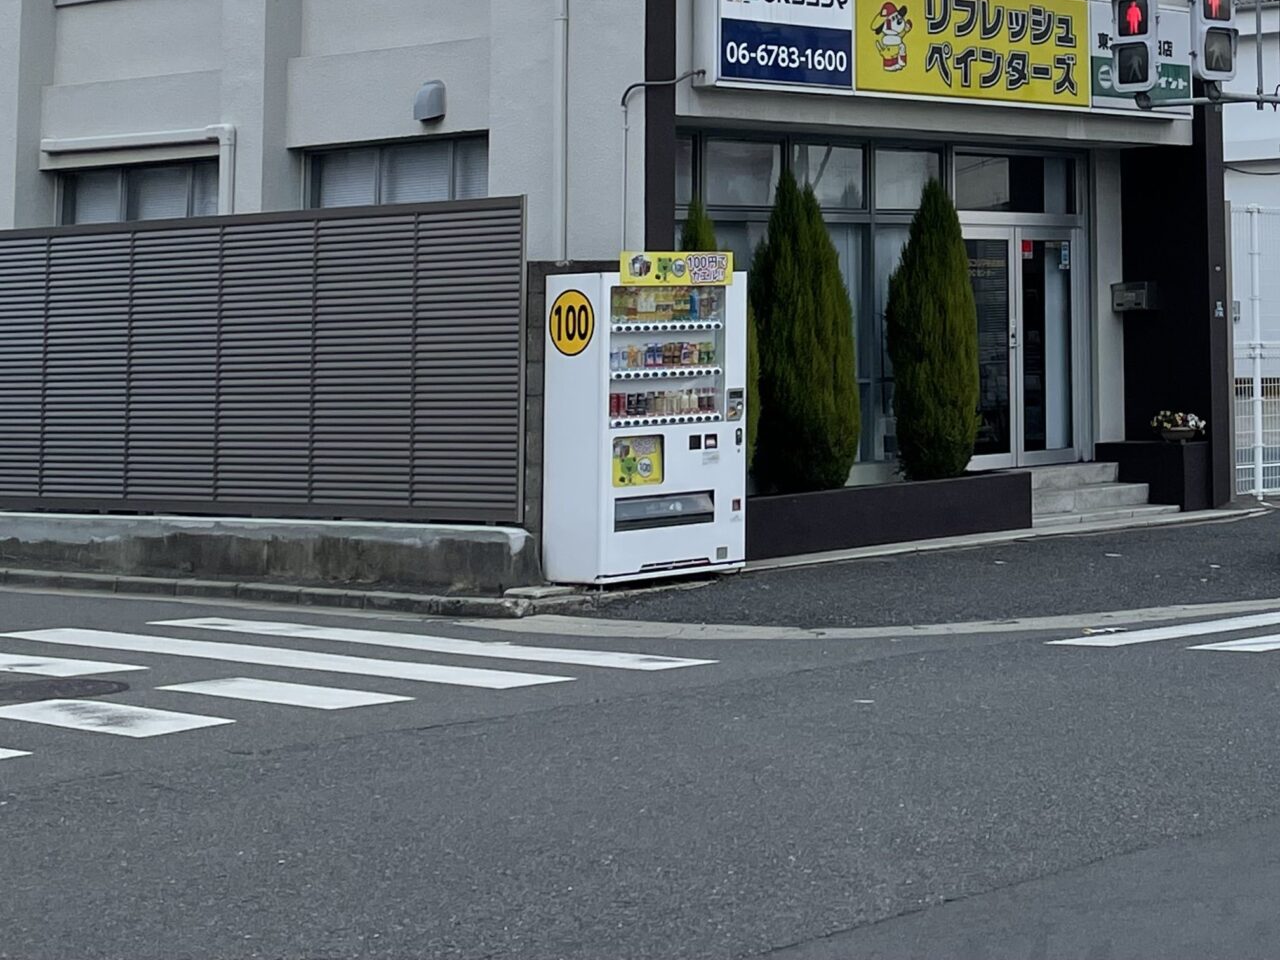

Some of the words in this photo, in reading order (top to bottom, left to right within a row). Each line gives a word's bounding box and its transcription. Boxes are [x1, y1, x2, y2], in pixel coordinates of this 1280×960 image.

[726, 41, 848, 72] 06-6783-1600
[925, 41, 1078, 95] ペインターズ
[554, 304, 589, 341] 100
